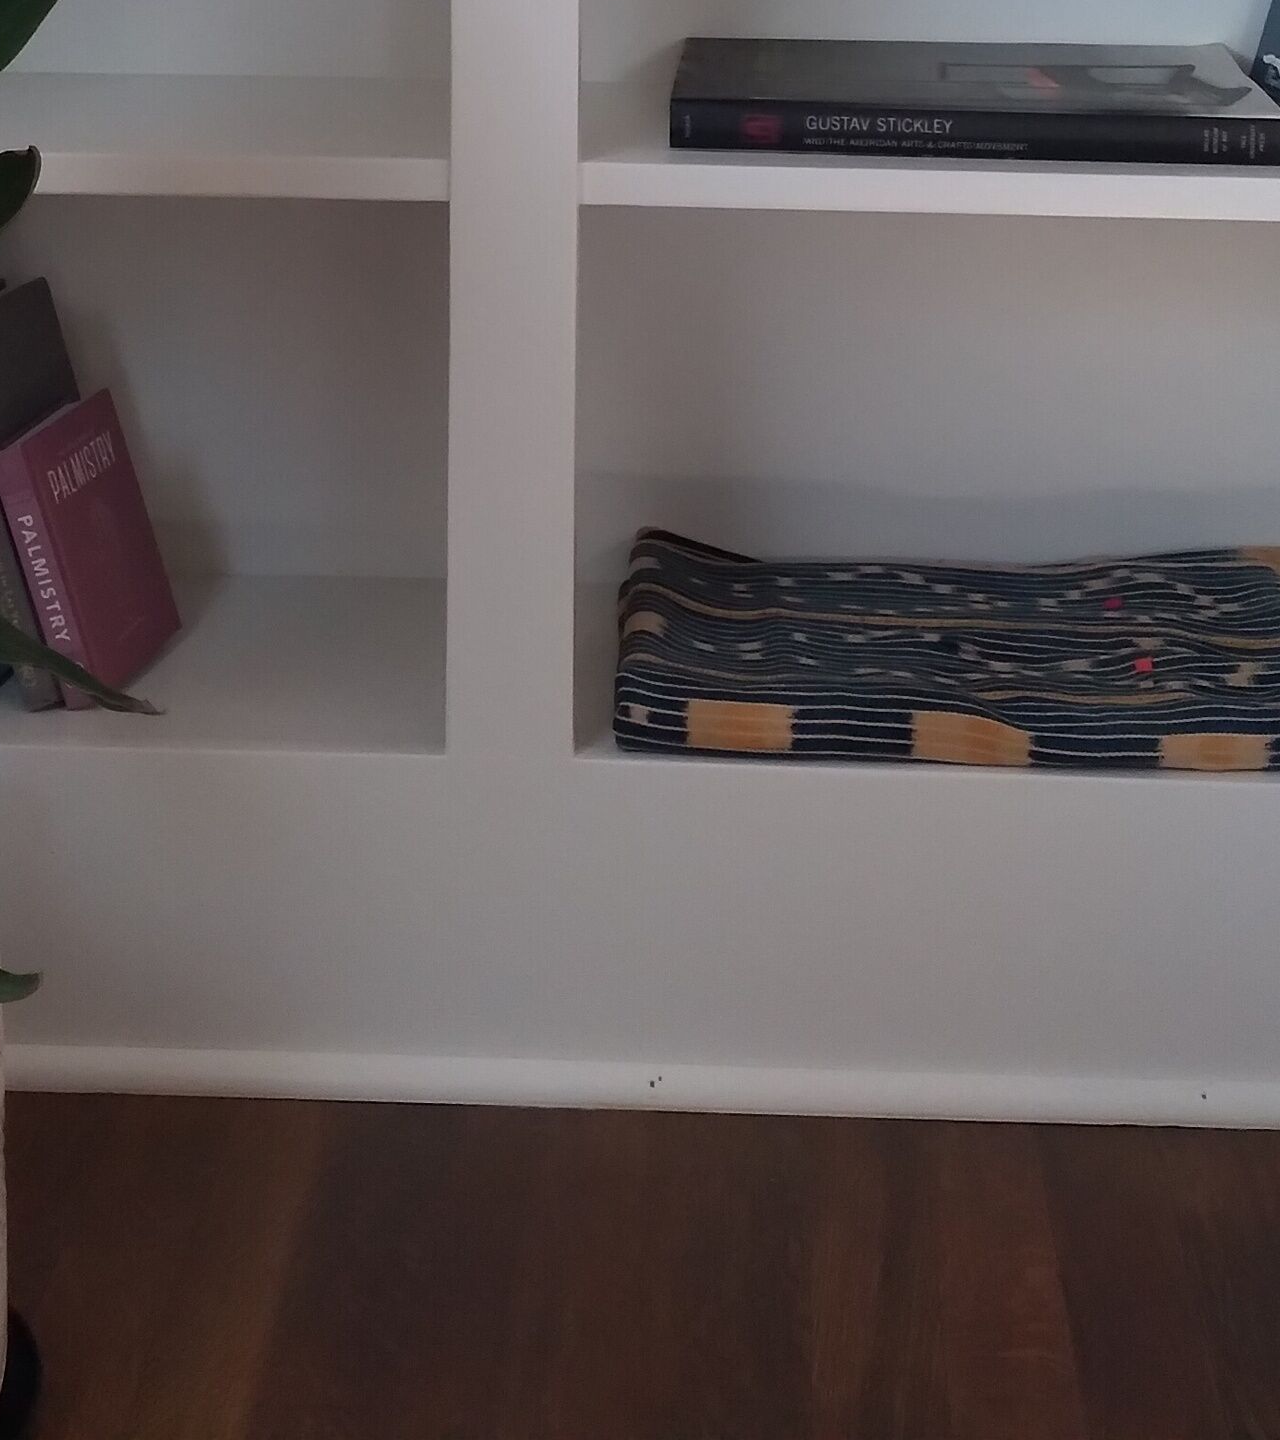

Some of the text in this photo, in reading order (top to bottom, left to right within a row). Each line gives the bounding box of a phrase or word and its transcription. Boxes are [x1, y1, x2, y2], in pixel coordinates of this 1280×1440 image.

[805, 115, 954, 134] GUSTAV STICKLEY
[46, 430, 116, 505] PALMISTRY
[17, 514, 71, 643] PALMISTRY
